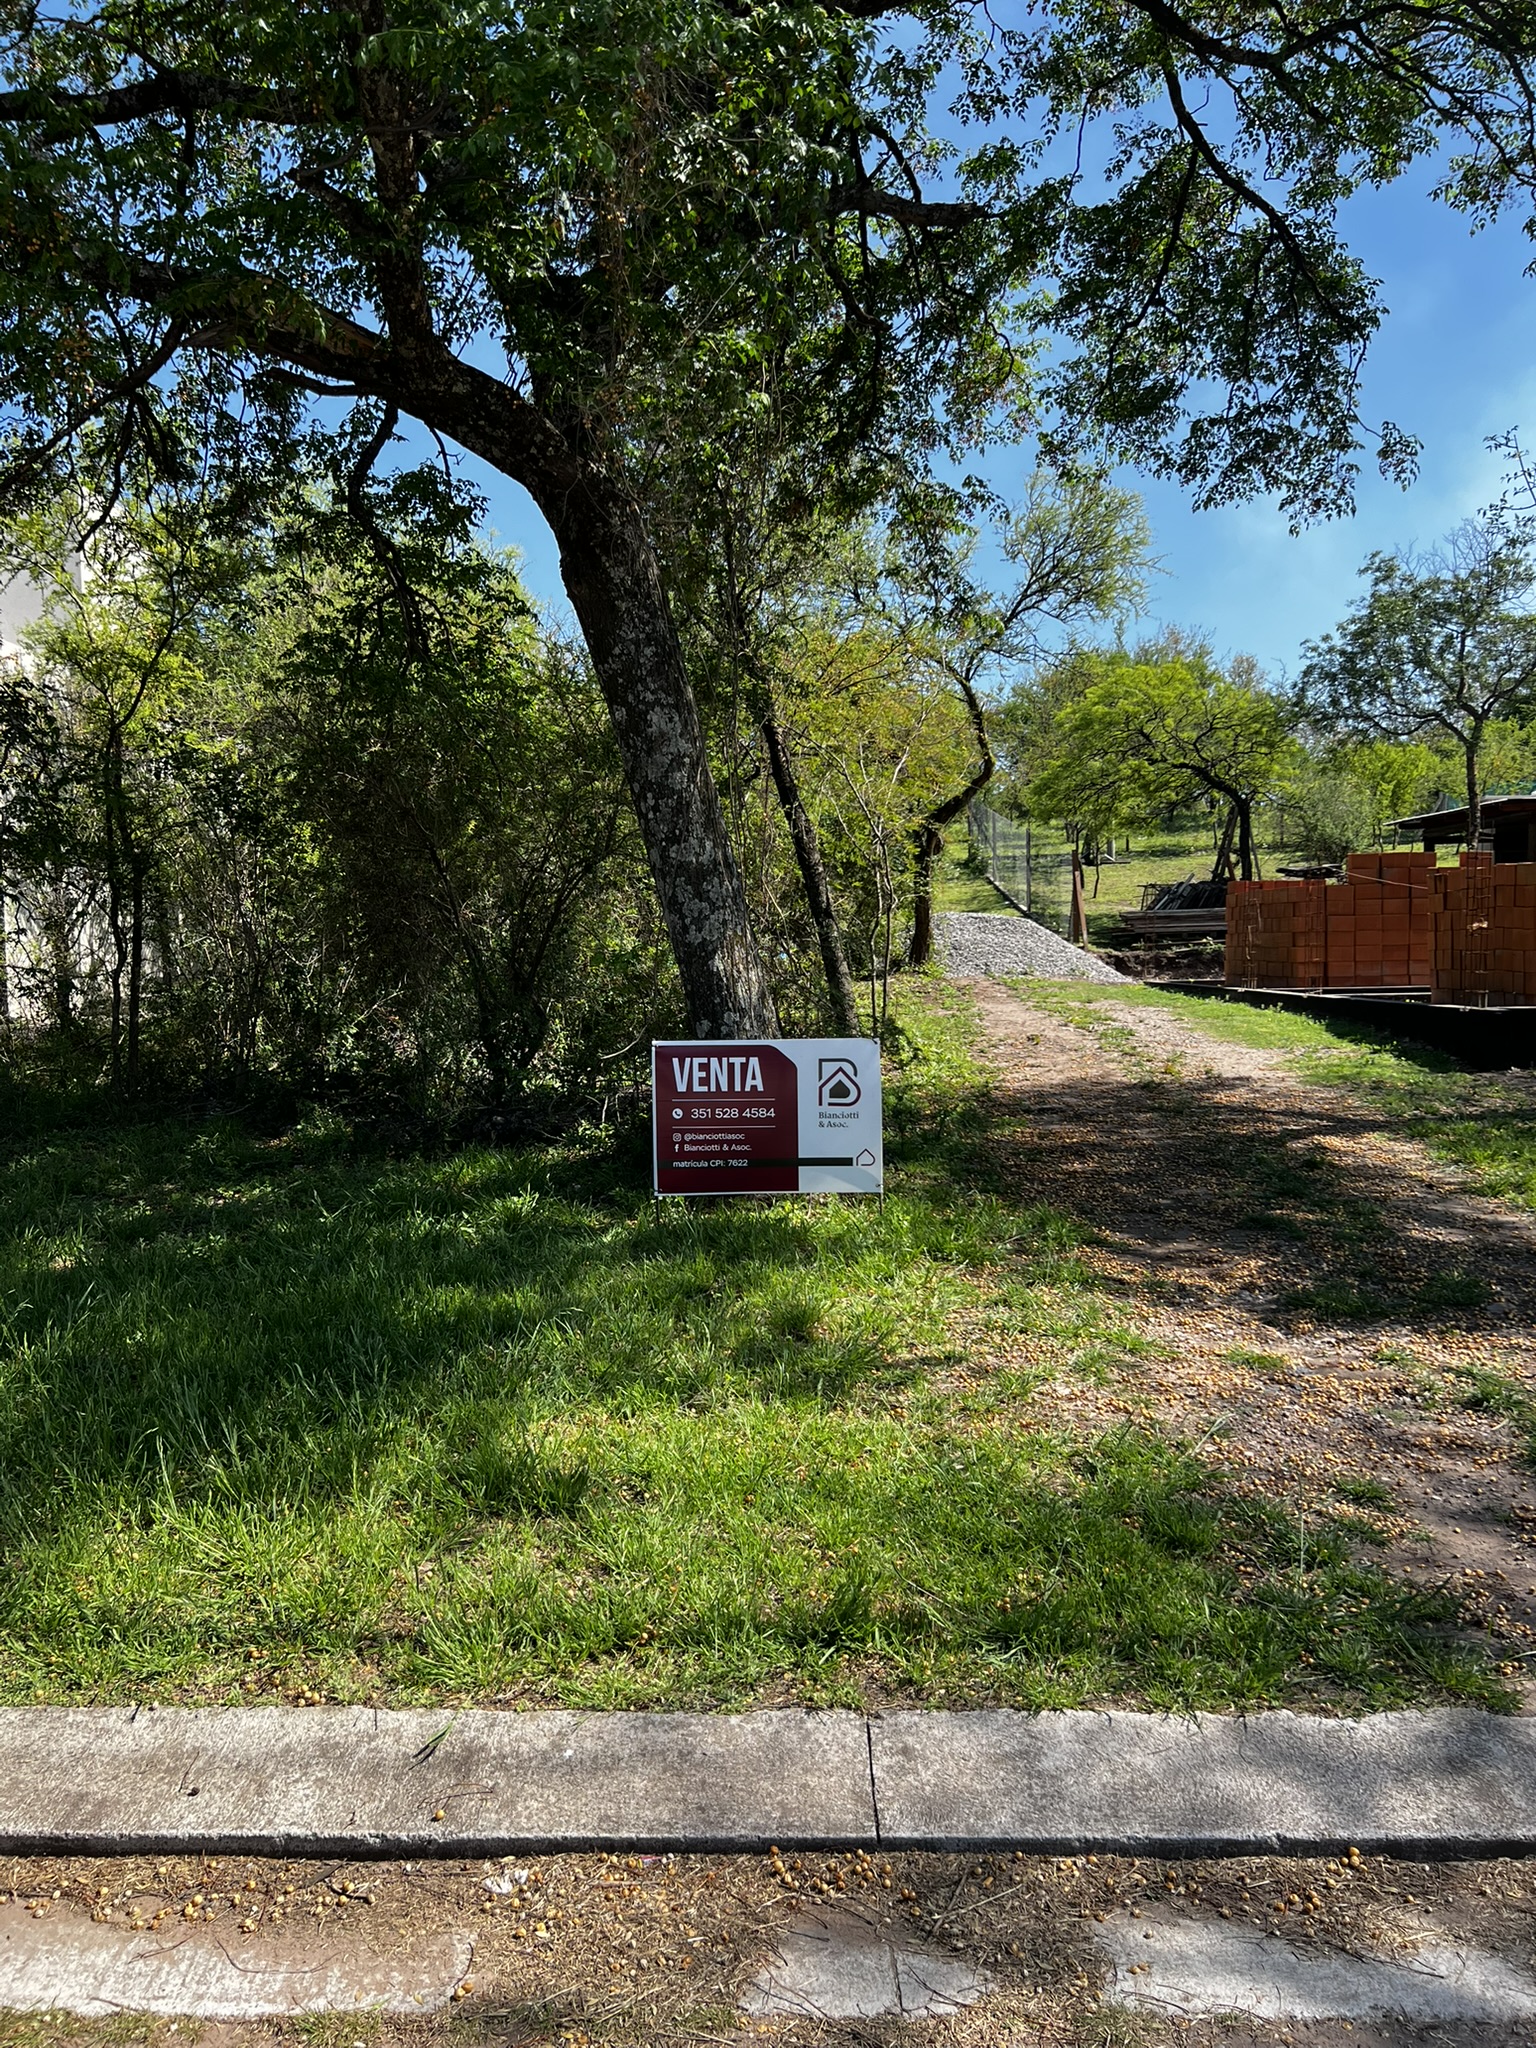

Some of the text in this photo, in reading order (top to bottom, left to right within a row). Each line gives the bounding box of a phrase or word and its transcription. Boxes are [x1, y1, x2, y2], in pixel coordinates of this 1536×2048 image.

[671, 1056, 764, 1092] VENTA
[690, 1107, 776, 1119] 351 528 4584
[818, 1111, 859, 1119] Bianciotti
[818, 1120, 849, 1128] & Asoc.
[684, 1132, 745, 1141] @bianciottiasoc
[684, 1143, 752, 1151] Bianciotti & Asoc.
[709, 1159, 725, 1167] CPI:
[728, 1159, 748, 1167] 7622
